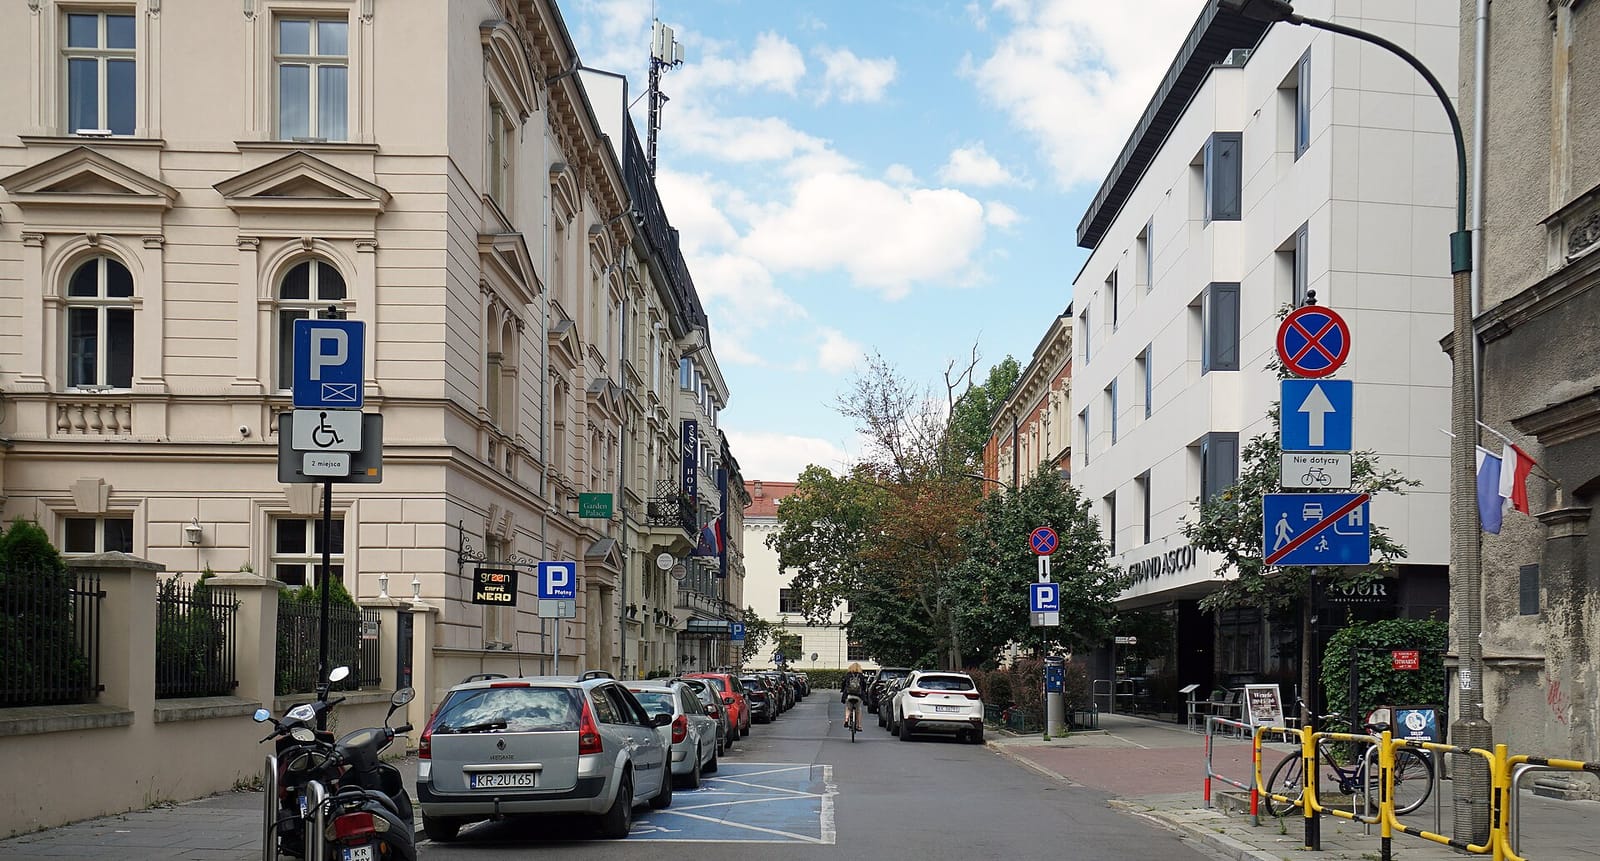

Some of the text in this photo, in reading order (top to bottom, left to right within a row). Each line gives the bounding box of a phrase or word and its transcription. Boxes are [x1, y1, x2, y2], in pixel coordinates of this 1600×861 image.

[310, 327, 349, 381] P
[317, 460, 341, 468] miejsca
[1293, 456, 1339, 466] Nie dotyczy
[686, 467, 694, 497] HOT
[583, 502, 608, 510] Garden
[1161, 545, 1197, 576] ASCOT
[480, 572, 510, 583] green
[546, 565, 569, 595] P
[1327, 583, 1387, 596] OUR
[476, 591, 512, 602] NERO
[1037, 586, 1054, 609] P
[733, 624, 742, 636] P
[477, 775, 494, 787] KR
[497, 774, 532, 786] 2U165
[354, 849, 367, 857] KR
